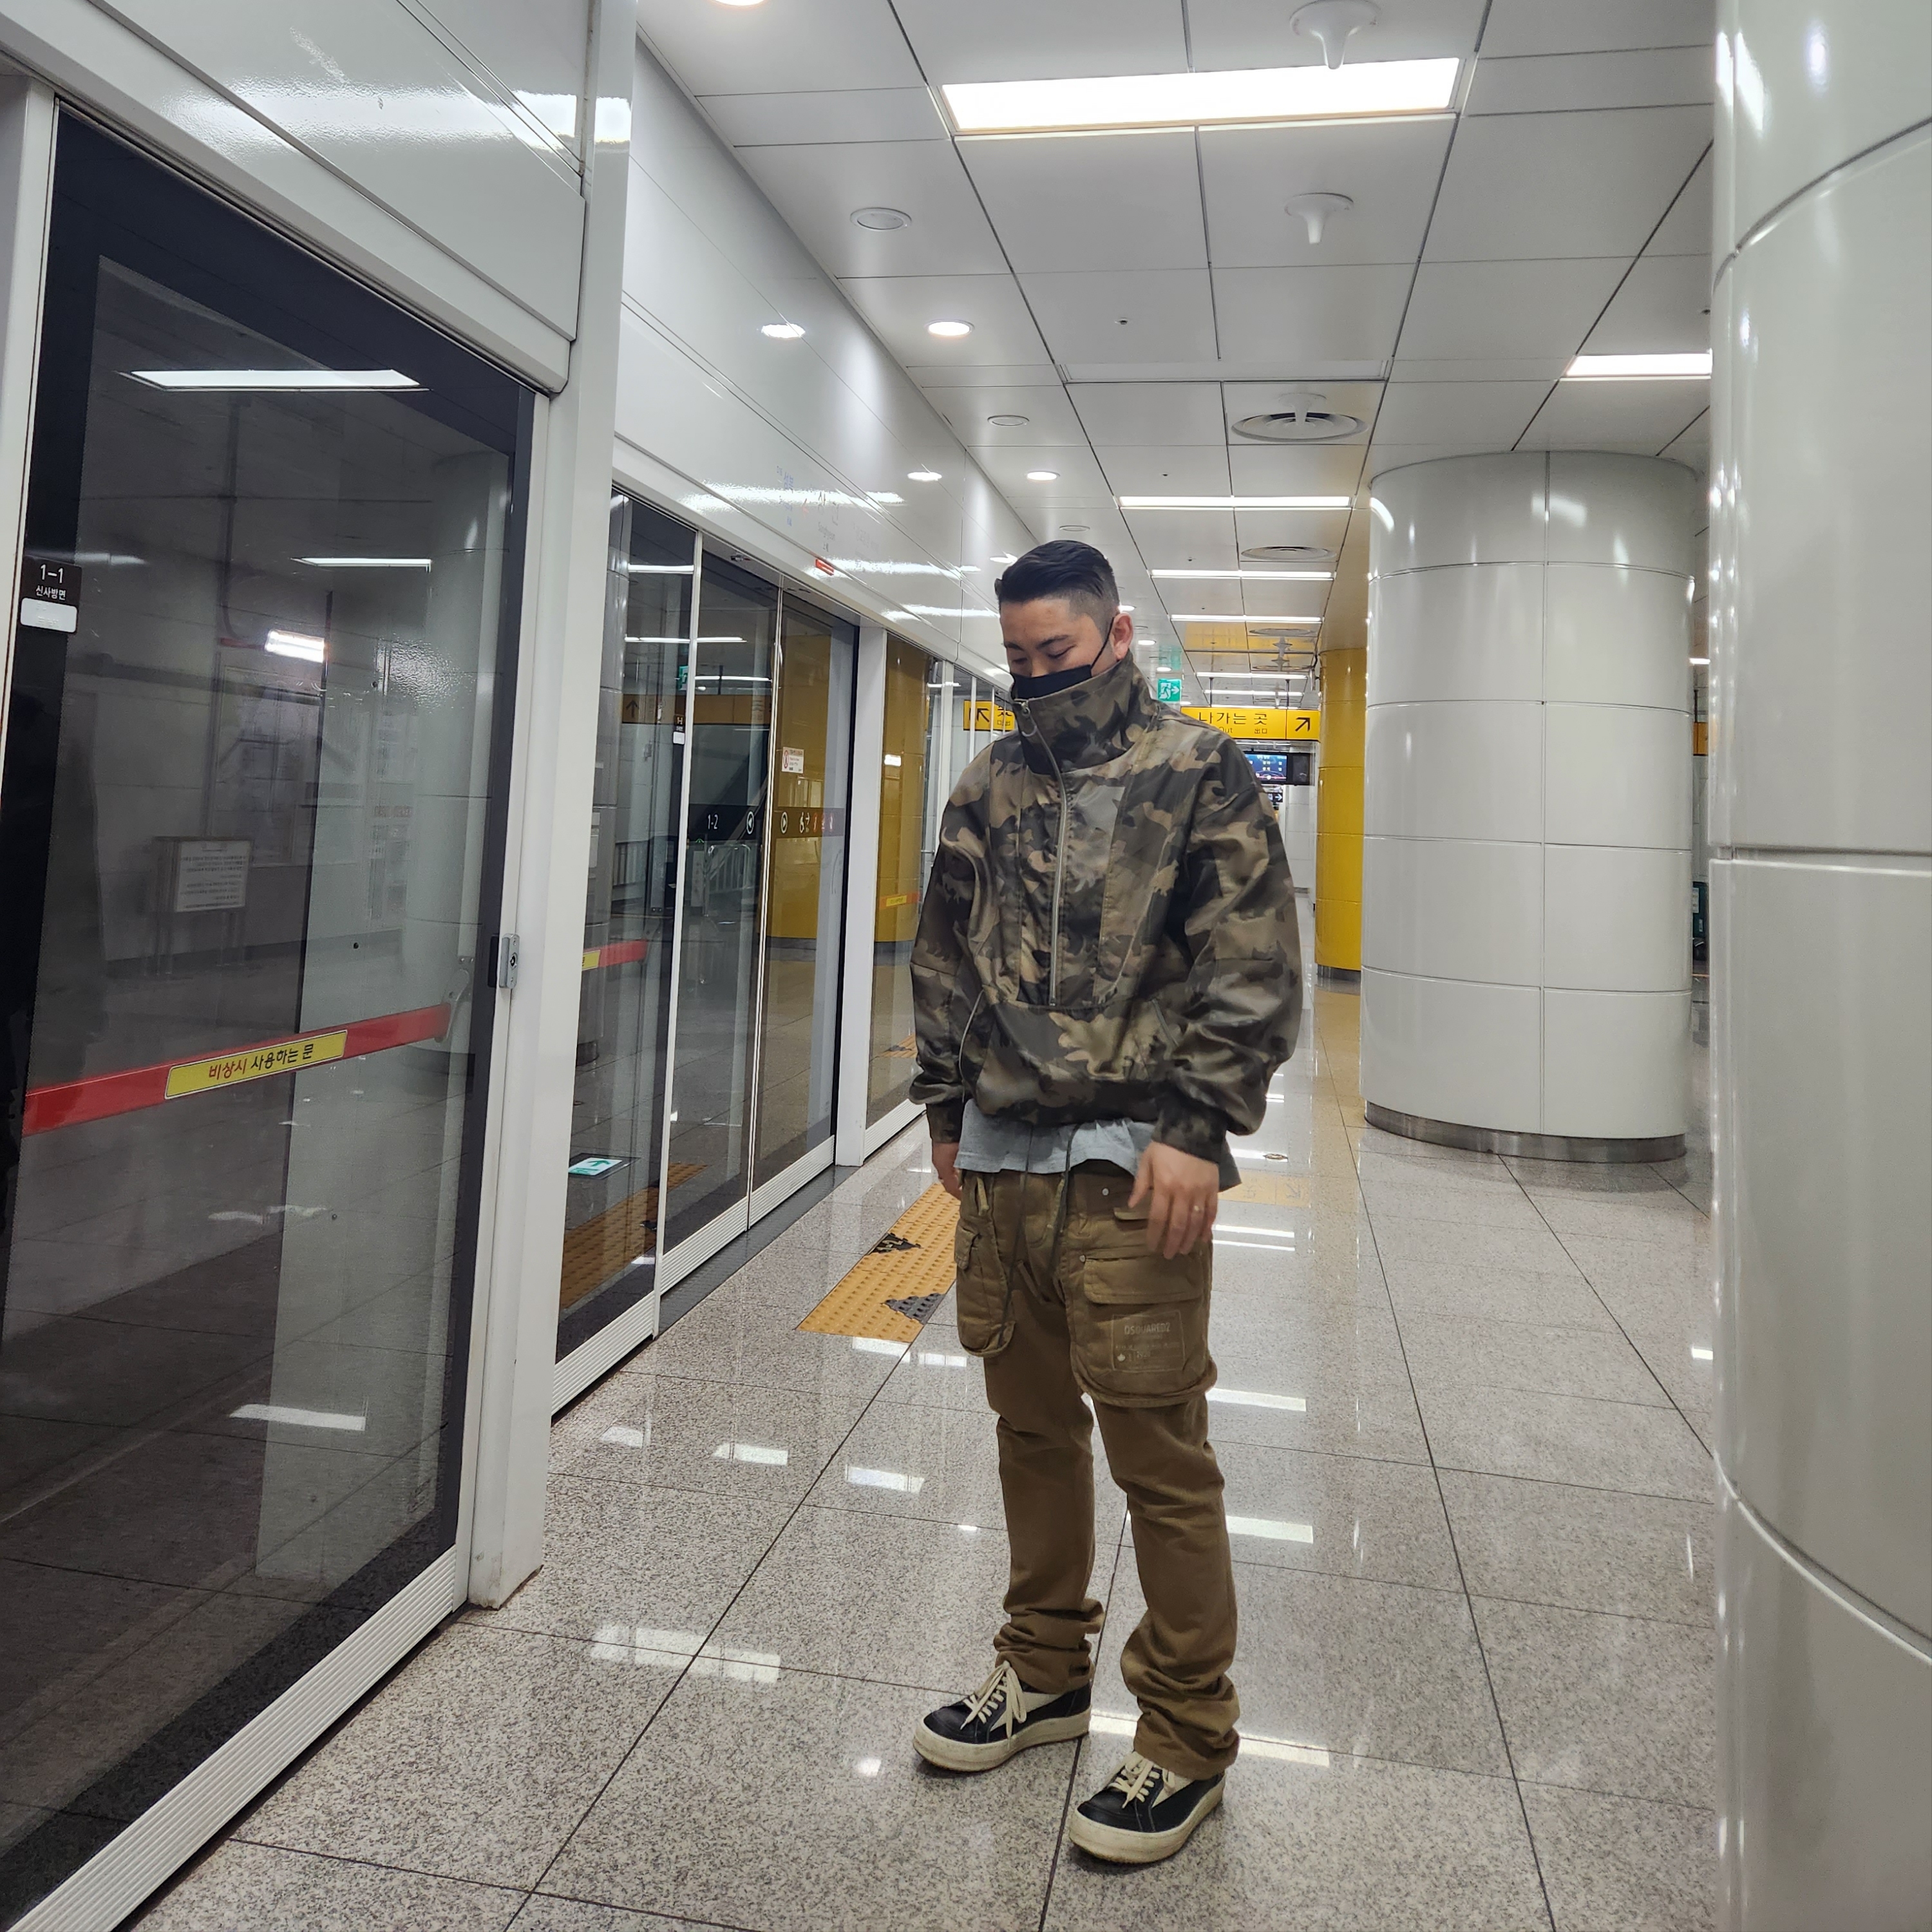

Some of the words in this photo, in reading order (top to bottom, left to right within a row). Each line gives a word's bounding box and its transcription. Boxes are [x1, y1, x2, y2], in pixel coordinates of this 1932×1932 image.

[40, 564, 64, 583] 1-1
[35, 585, 67, 600] 신사방면
[1198, 712, 1247, 725] 나가는
[1253, 713, 1267, 725] 곳
[707, 814, 719, 830] 1-2
[208, 1058, 248, 1081] 비상시
[251, 1048, 299, 1071] 사용하는
[302, 1043, 314, 1060] 문
